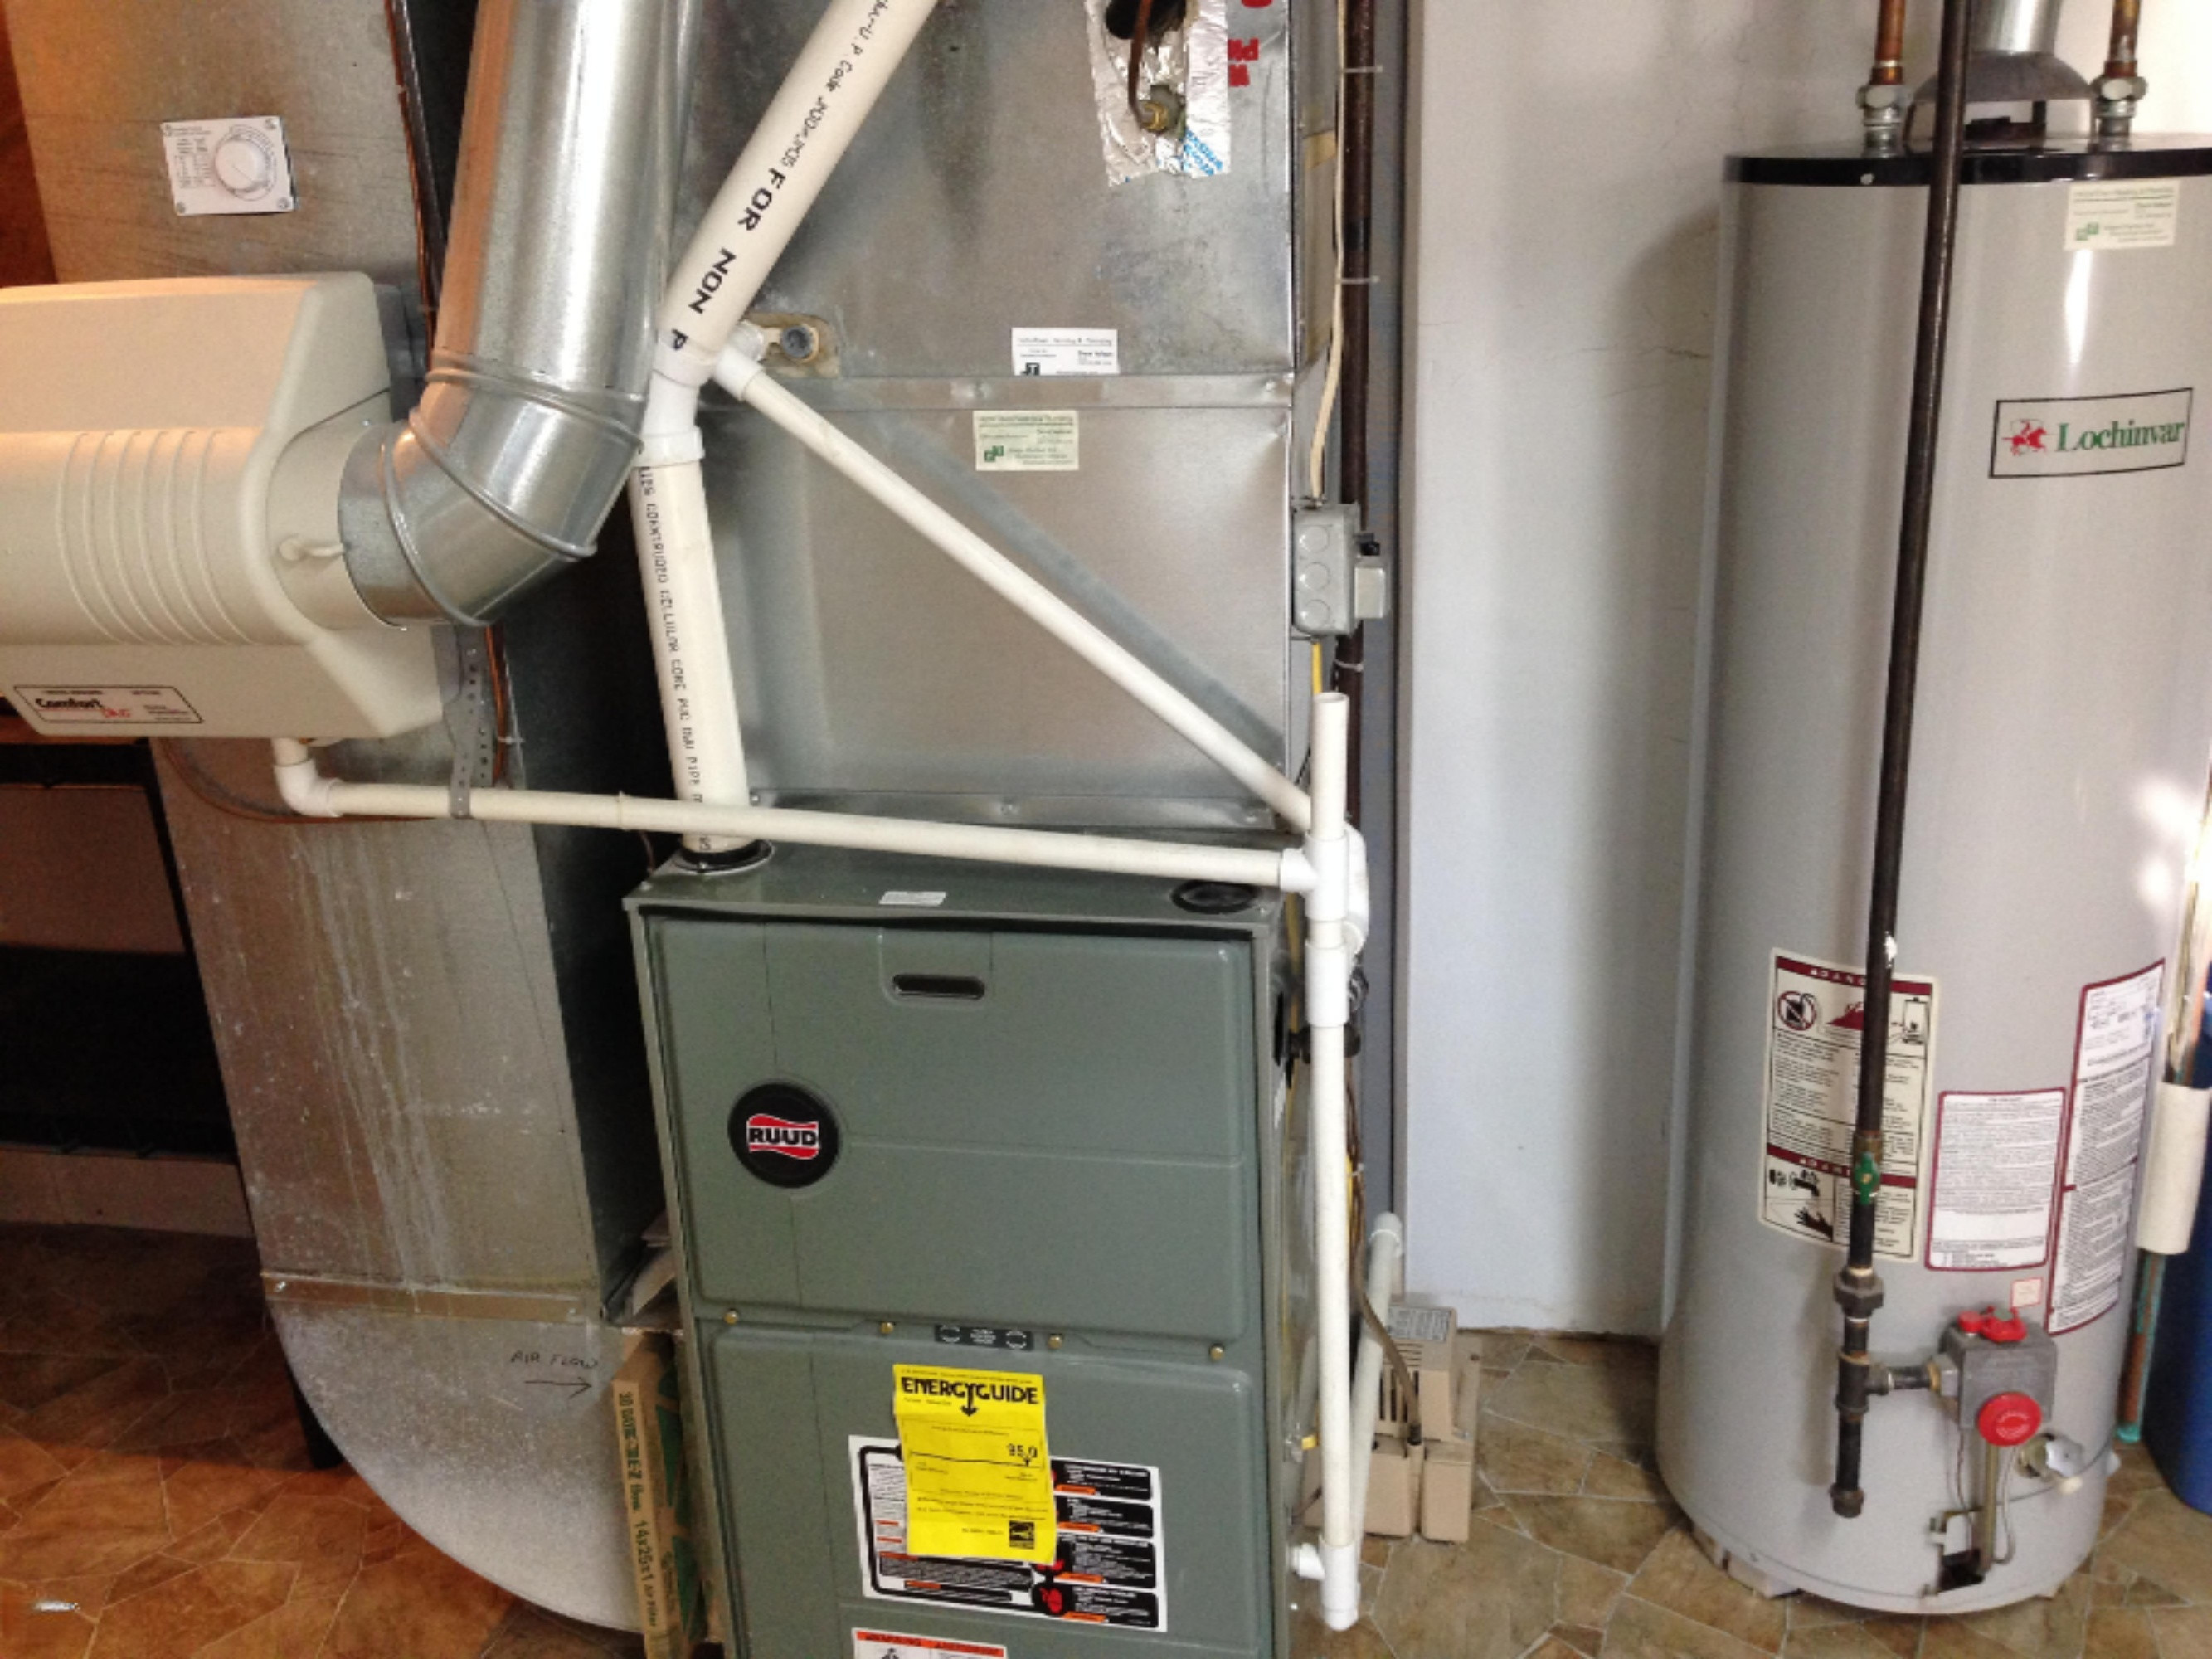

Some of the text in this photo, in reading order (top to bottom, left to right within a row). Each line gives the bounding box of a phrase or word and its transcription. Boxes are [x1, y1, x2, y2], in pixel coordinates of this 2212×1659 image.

[737, 167, 787, 231] FOR
[688, 247, 737, 314] NON
[2054, 418, 2186, 453] Lochinvar
[747, 1126, 819, 1147] RUUD
[510, 1350, 599, 1370] AIR FLOW
